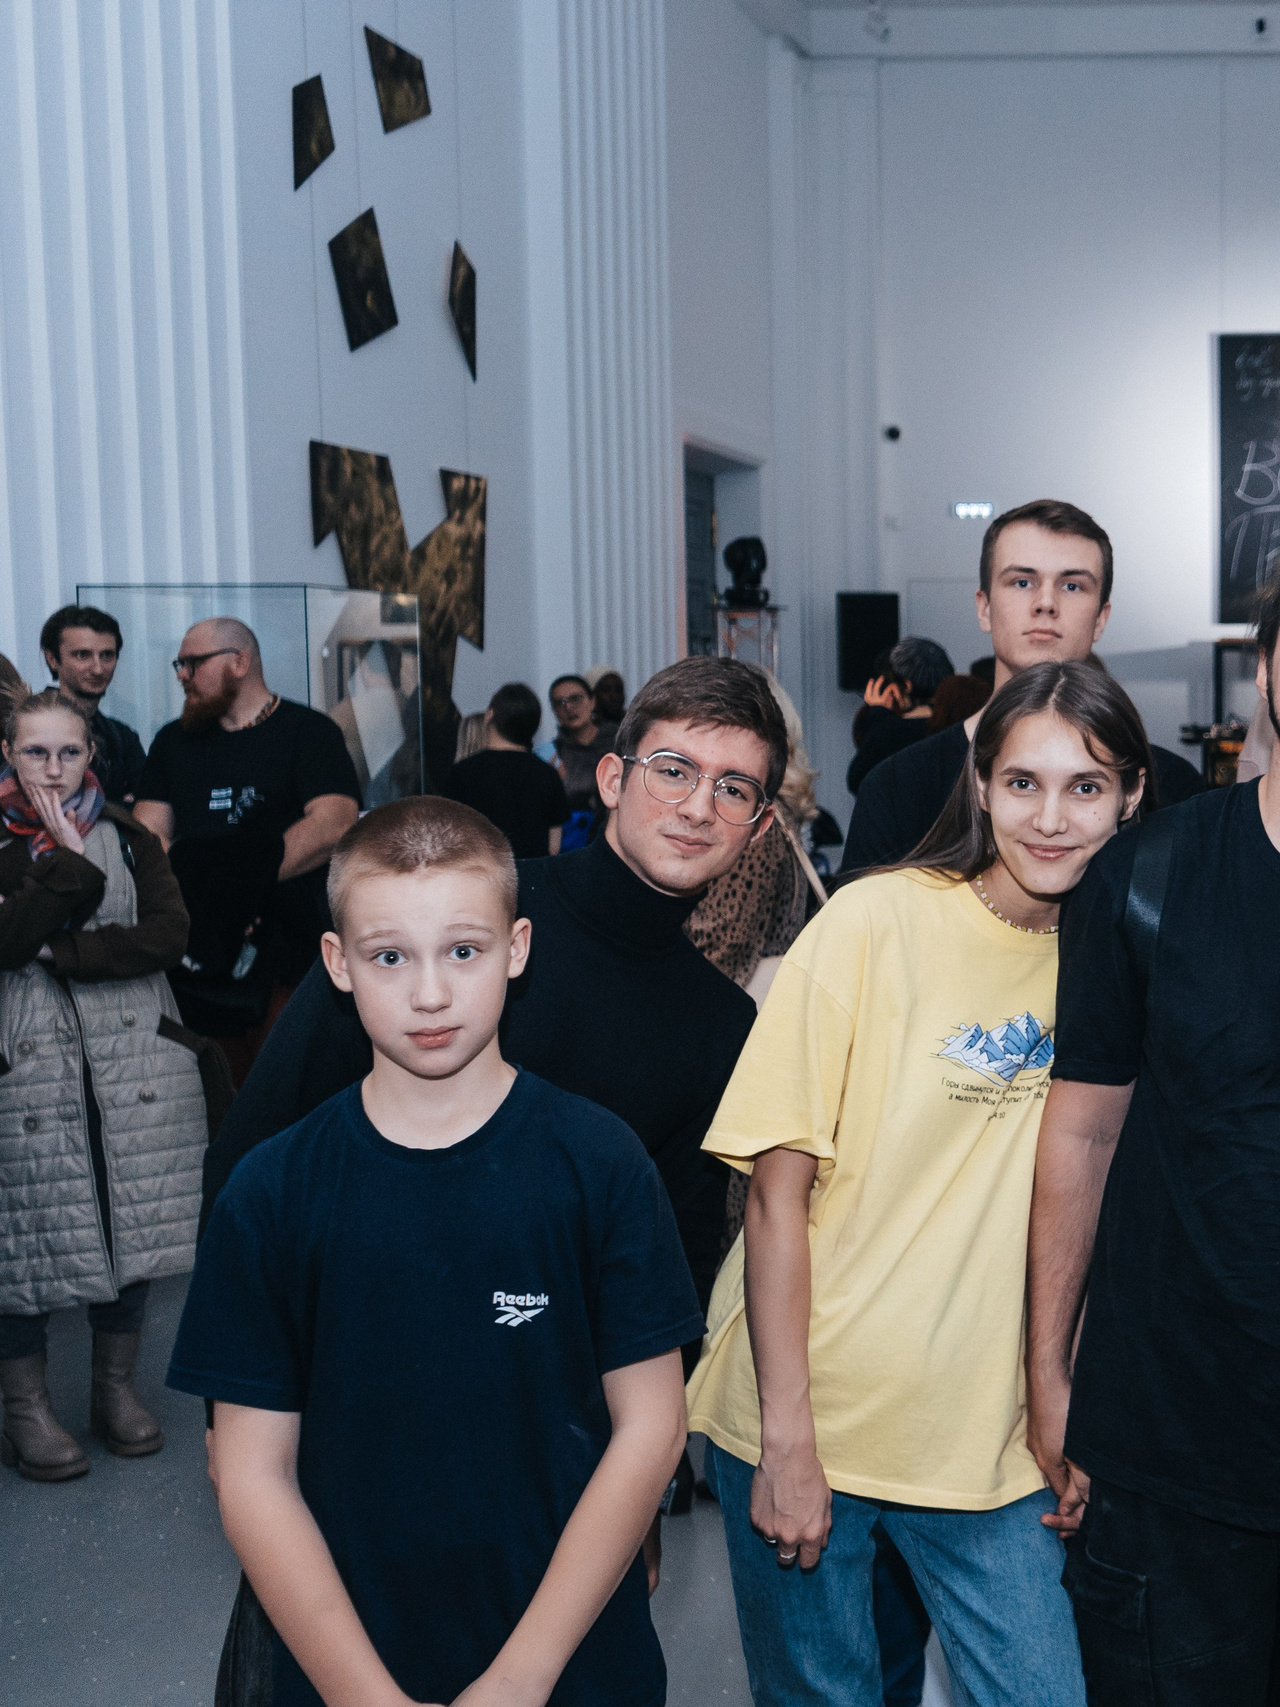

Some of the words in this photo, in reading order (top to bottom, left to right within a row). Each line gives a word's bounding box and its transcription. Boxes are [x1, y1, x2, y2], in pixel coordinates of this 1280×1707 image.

[941, 1077, 959, 1089] Горы
[955, 1094, 979, 1103] милость
[981, 1096, 996, 1106] Моя
[492, 1291, 549, 1306] Reebok
